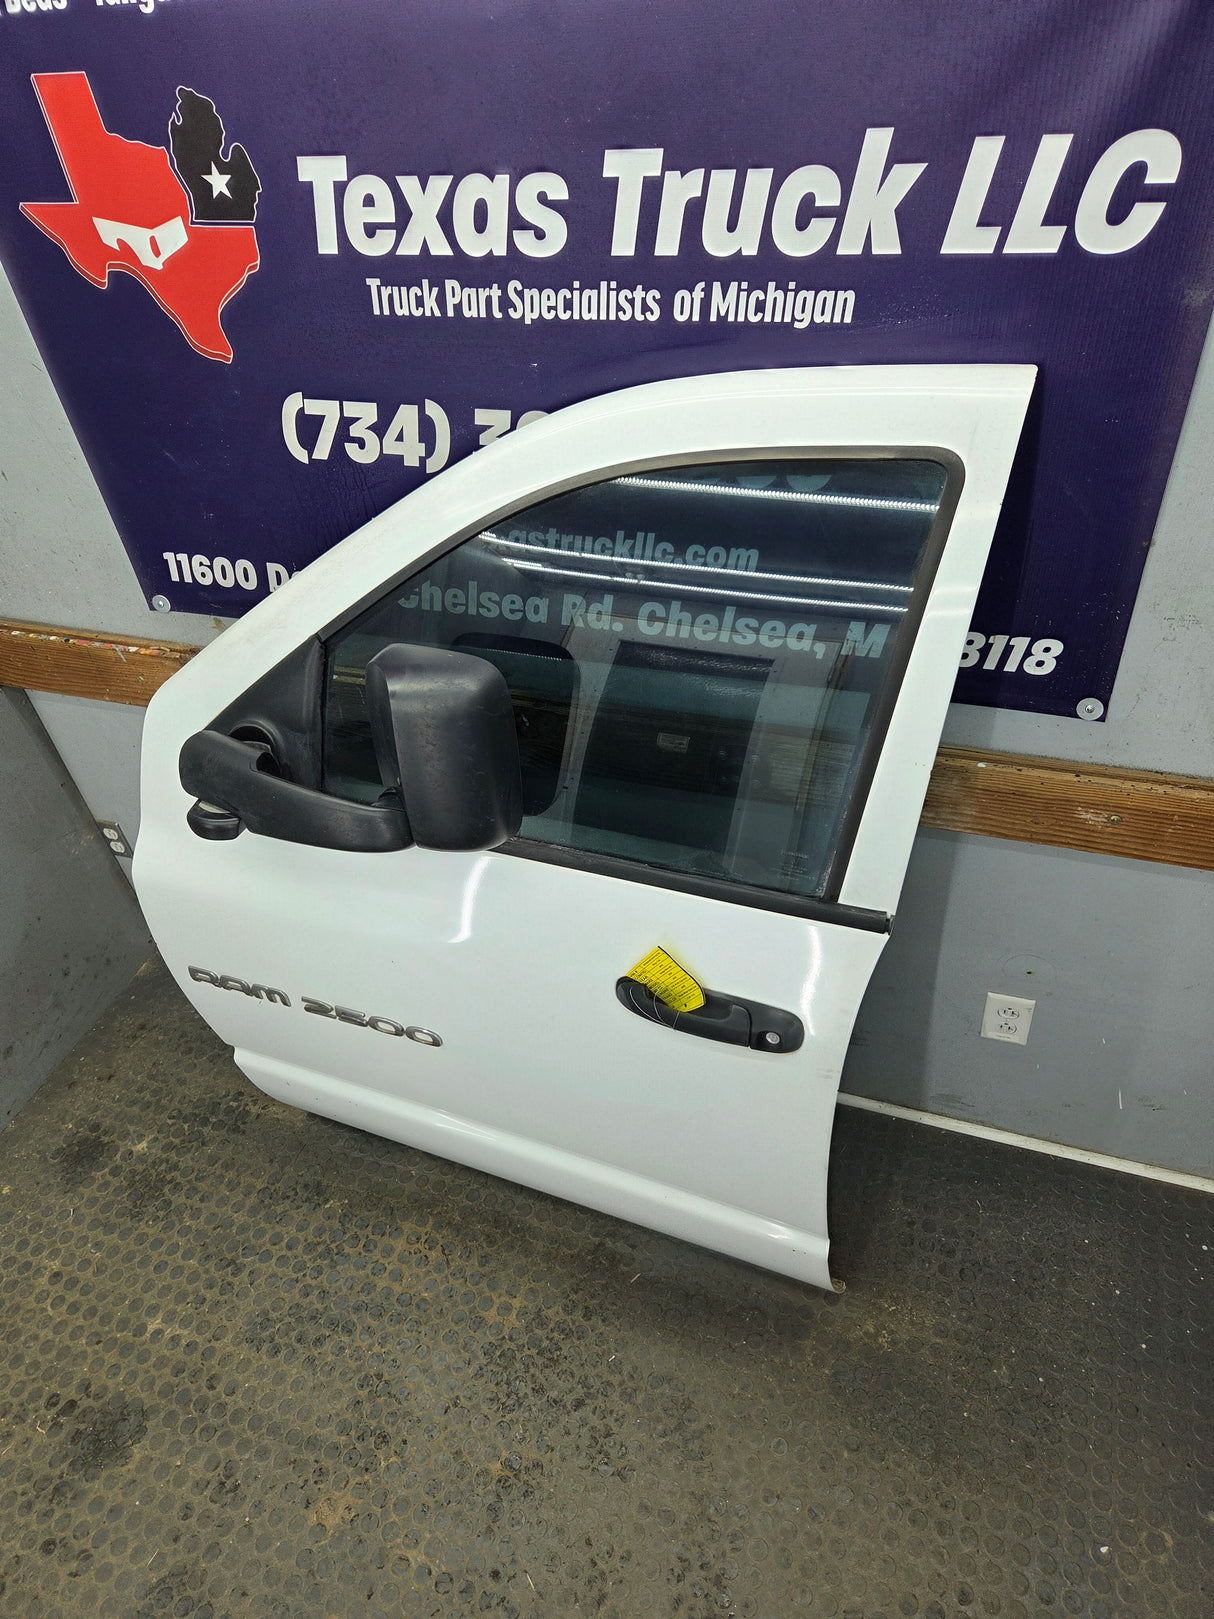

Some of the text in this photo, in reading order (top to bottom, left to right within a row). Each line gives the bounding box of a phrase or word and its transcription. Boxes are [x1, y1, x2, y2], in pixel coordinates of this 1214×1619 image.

[297, 127, 1183, 258] Texas Truck LLC
[366, 278, 856, 329] Truck Part Specialists of Michigan
[281, 392, 450, 474] (734)
[162, 552, 258, 591] 11600
[561, 593, 624, 632] Rd.
[637, 601, 827, 659] Chelsea,
[301, 996, 443, 1047] 2500
